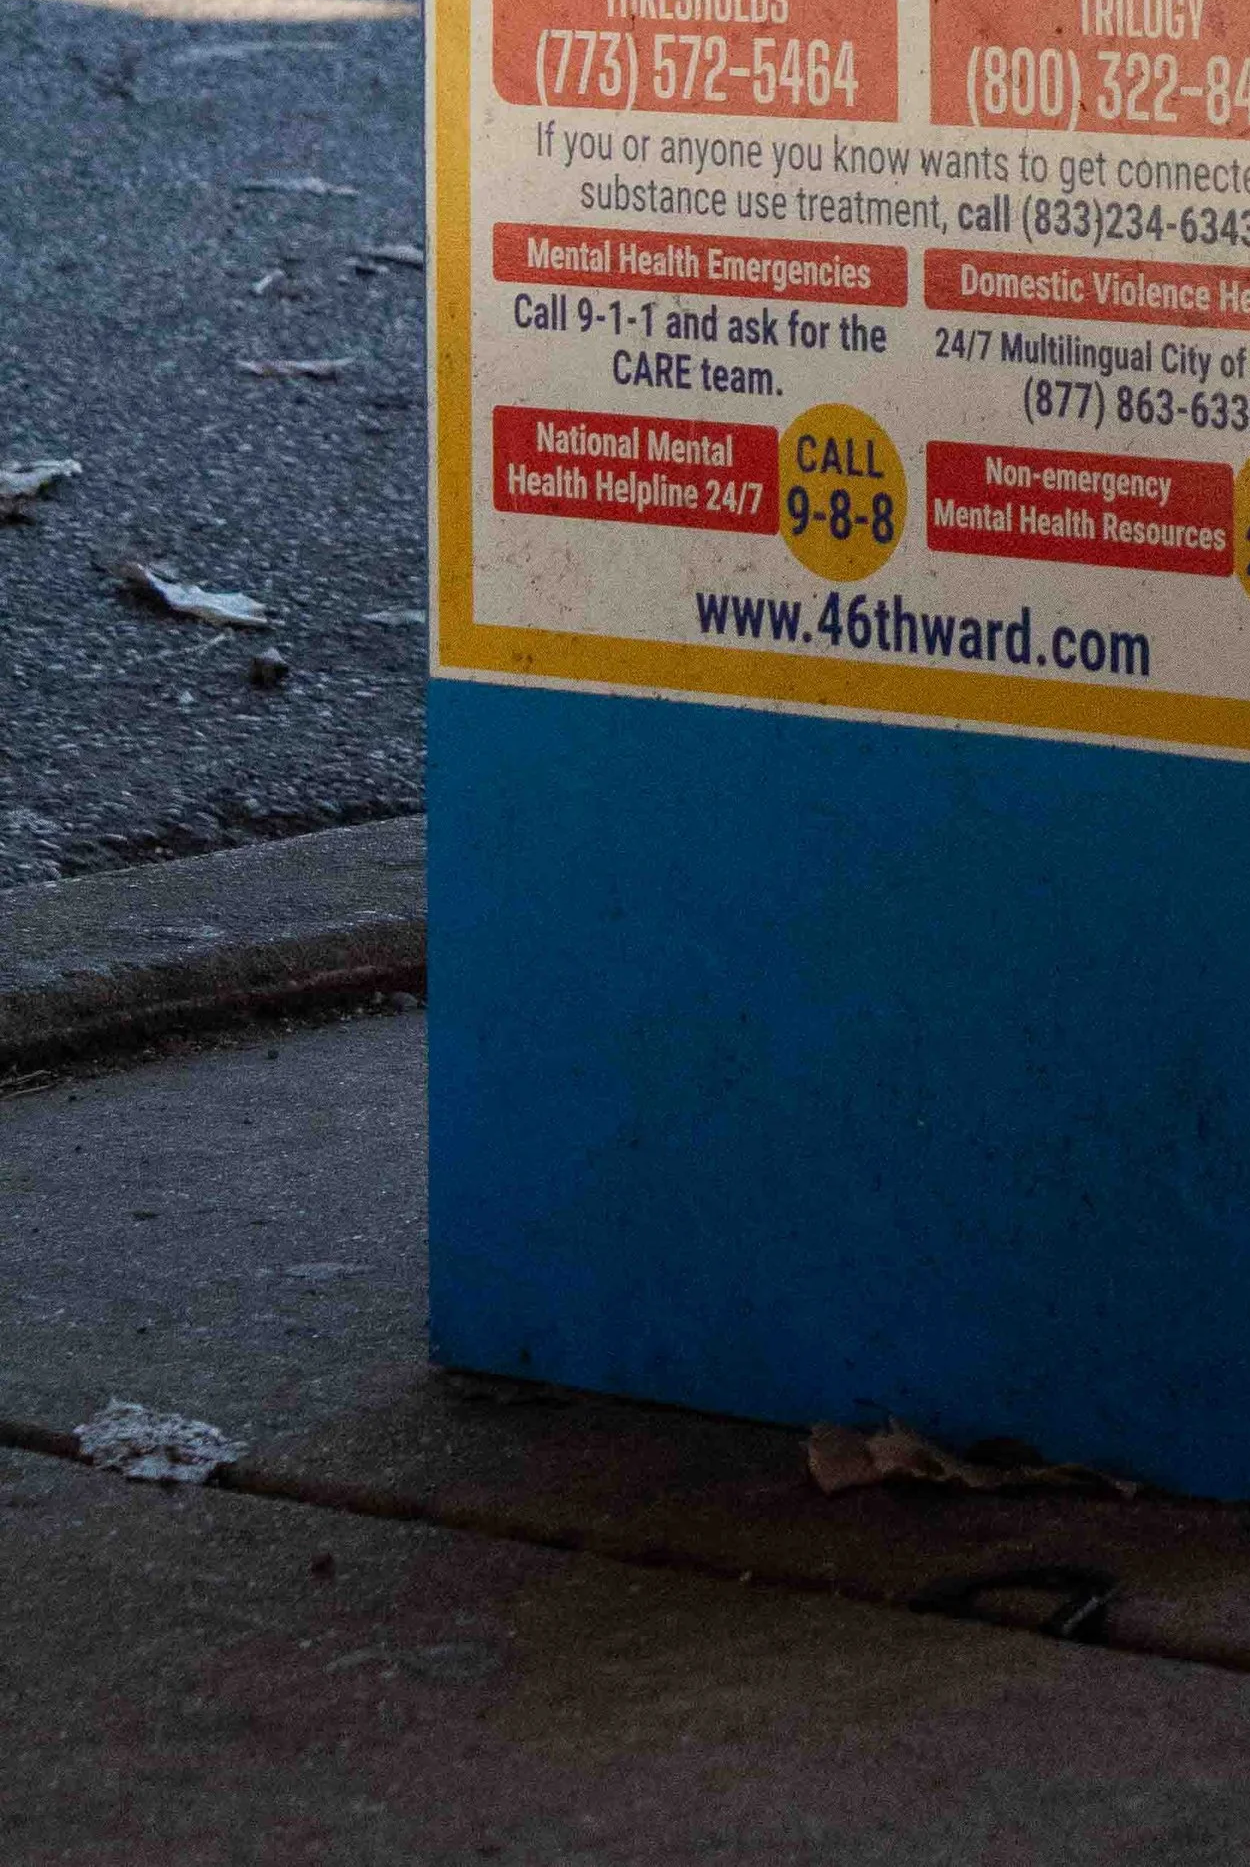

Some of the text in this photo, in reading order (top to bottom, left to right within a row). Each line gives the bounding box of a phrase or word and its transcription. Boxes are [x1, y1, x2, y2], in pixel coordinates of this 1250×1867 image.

[536, 29, 858, 111] (773) 572-5464
[966, 45, 1082, 132] (800)
[537, 121, 554, 157] If
[566, 129, 612, 167] you
[624, 134, 650, 162] or
[661, 132, 762, 175] anyone
[773, 137, 822, 177] you
[834, 134, 909, 175] know
[920, 146, 1008, 182] wants
[1019, 146, 1047, 183] to
[1061, 151, 1106, 193] get
[581, 174, 727, 216] substance
[738, 190, 786, 220] use
[798, 191, 947, 235] treatment,
[958, 194, 1010, 233] call
[527, 237, 871, 292] Mental Health Emergencies
[961, 264, 1084, 303] Domestic
[1093, 272, 1210, 311] Violence
[515, 293, 887, 353] Call 9-1-1 and ask for the
[613, 349, 783, 397] CARE team.
[935, 327, 993, 361] 24/7
[1002, 332, 1151, 376] Multilingual
[1161, 343, 1211, 384] City
[1220, 349, 1247, 379] of
[1023, 375, 1105, 429] (877)
[536, 421, 732, 467] National Mental
[796, 434, 883, 479] CALL
[508, 464, 763, 516] Health Helpline 24/7
[985, 456, 1171, 507] Non-emergency
[787, 487, 894, 544] 9-8-8
[934, 498, 1225, 552] Mental Health Resources
[696, 591, 1150, 677] www.46thward.com
